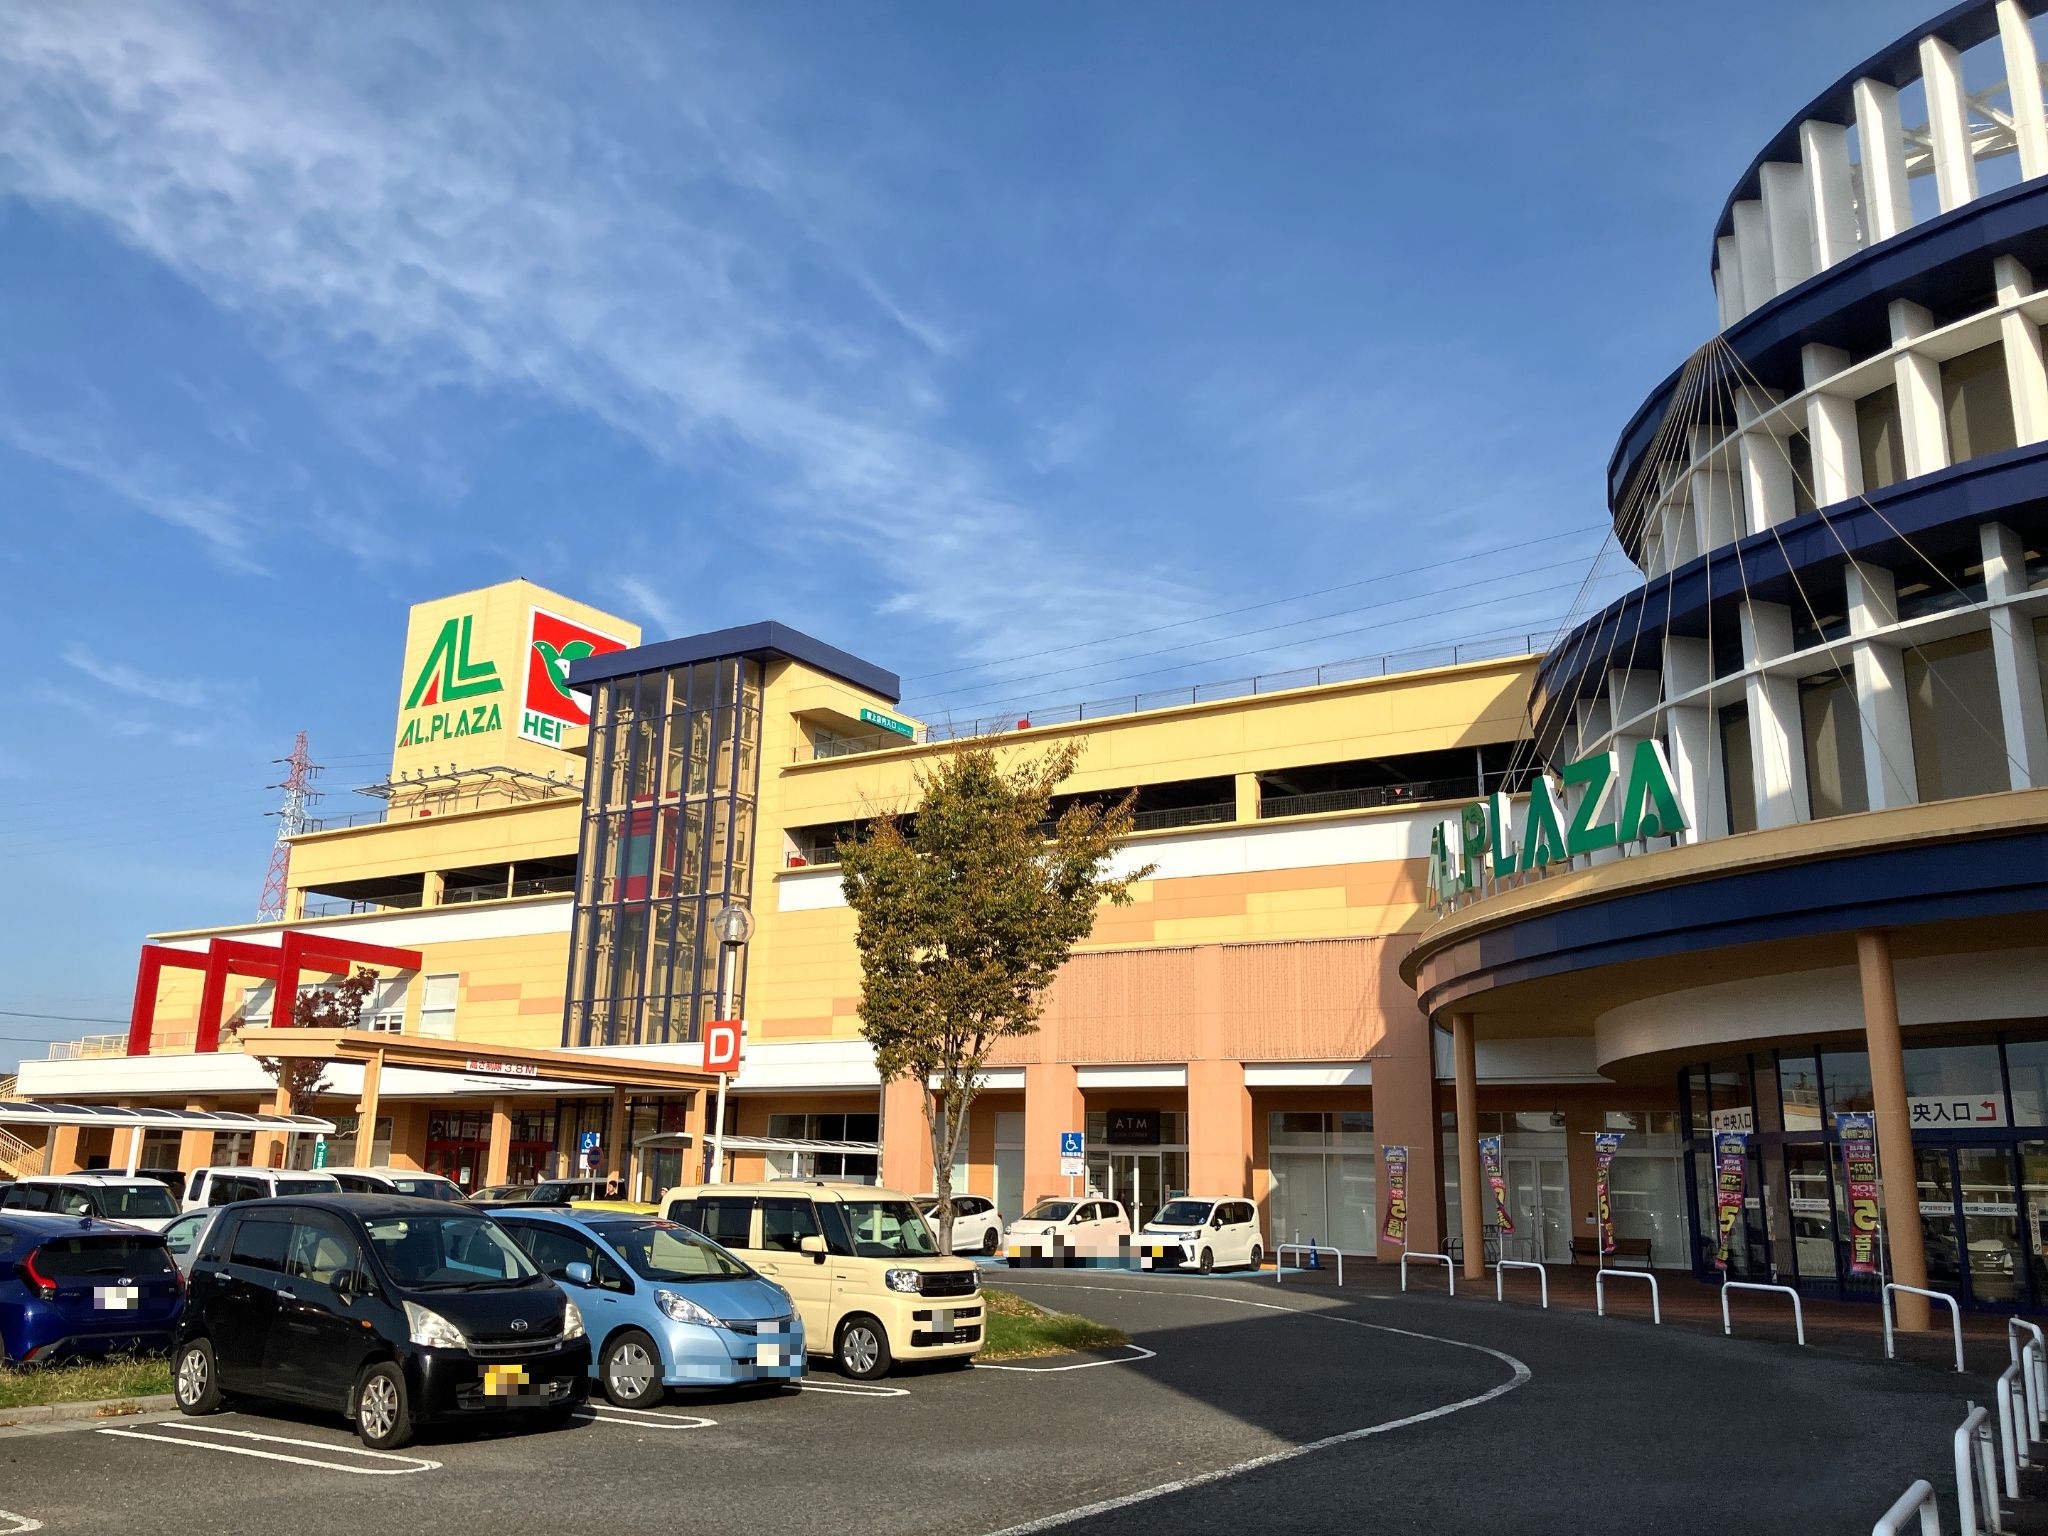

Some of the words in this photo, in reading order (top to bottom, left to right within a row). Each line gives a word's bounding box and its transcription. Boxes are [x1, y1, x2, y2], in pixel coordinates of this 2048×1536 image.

[398, 703, 502, 748] AL.PLAZA
[523, 711, 568, 743] HEI
[708, 1027, 735, 1064] D
[1115, 1117, 1147, 1129] ATM
[1723, 1113, 1752, 1130] 中央入口
